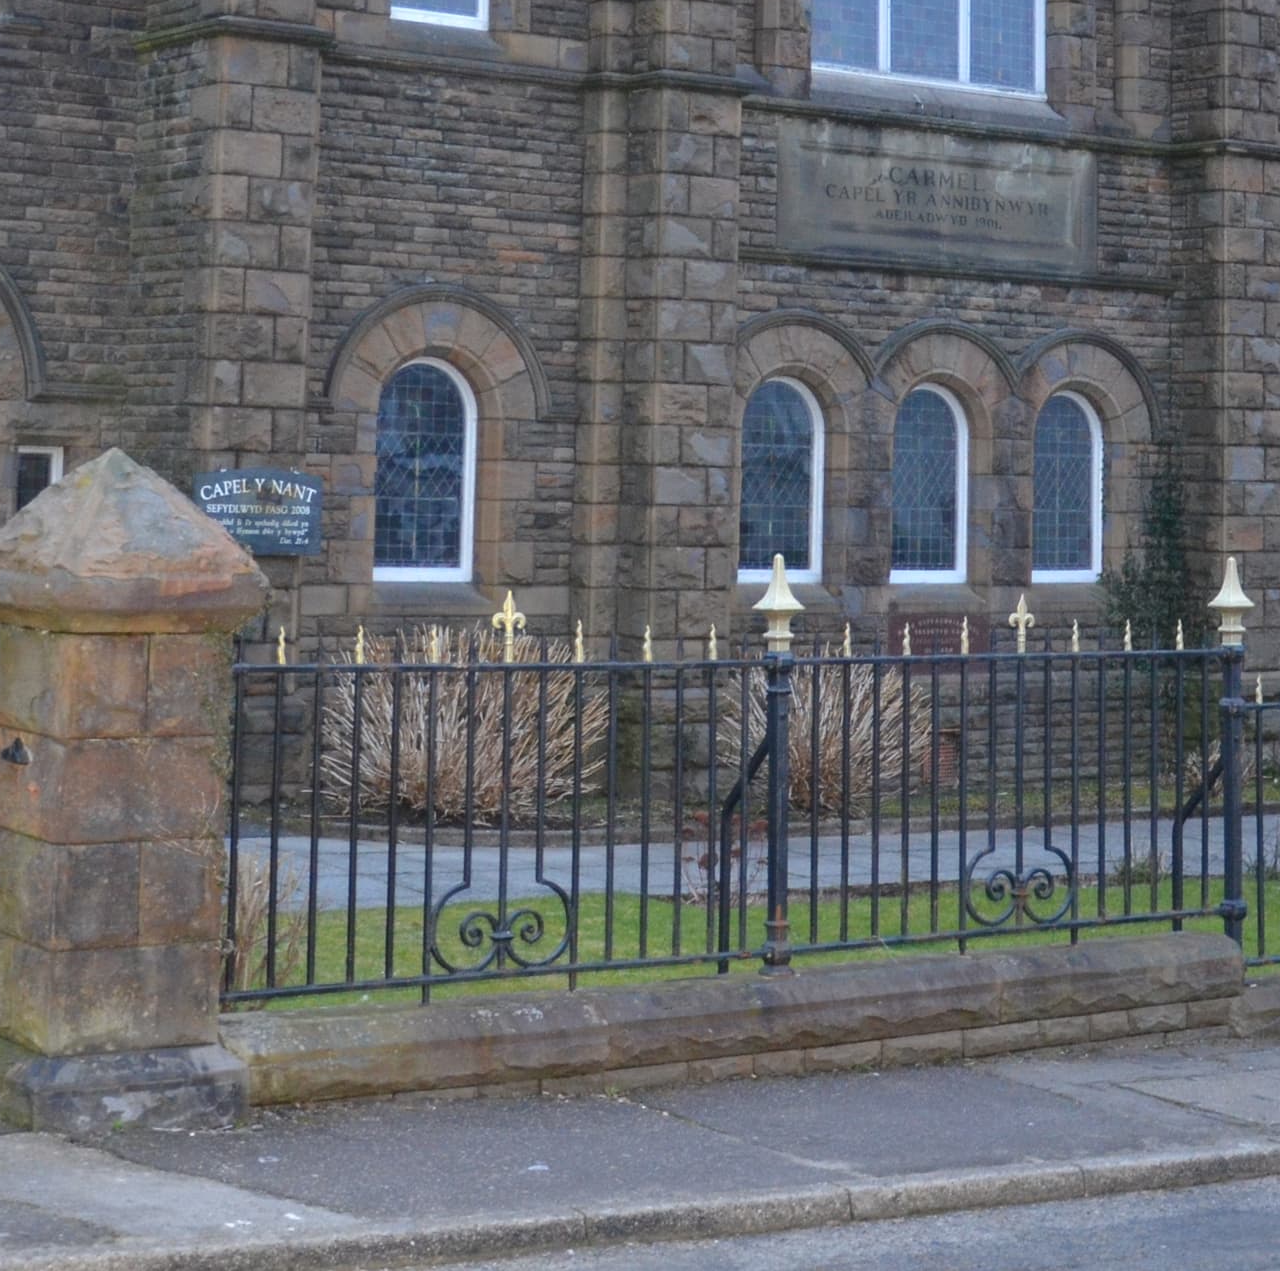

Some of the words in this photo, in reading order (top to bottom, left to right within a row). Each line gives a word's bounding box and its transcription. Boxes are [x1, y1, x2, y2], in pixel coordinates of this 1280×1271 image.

[889, 166, 984, 192] CARMEL
[825, 183, 886, 203] CAPEL
[893, 189, 917, 205] YR
[926, 194, 1049, 216] ANNIBYNWYR
[874, 209, 968, 226] ADEILADWYD
[200, 478, 251, 501] CAPEL
[254, 478, 266, 493] Y
[271, 479, 317, 503] NANT
[206, 503, 262, 514] SEFYDLWYD
